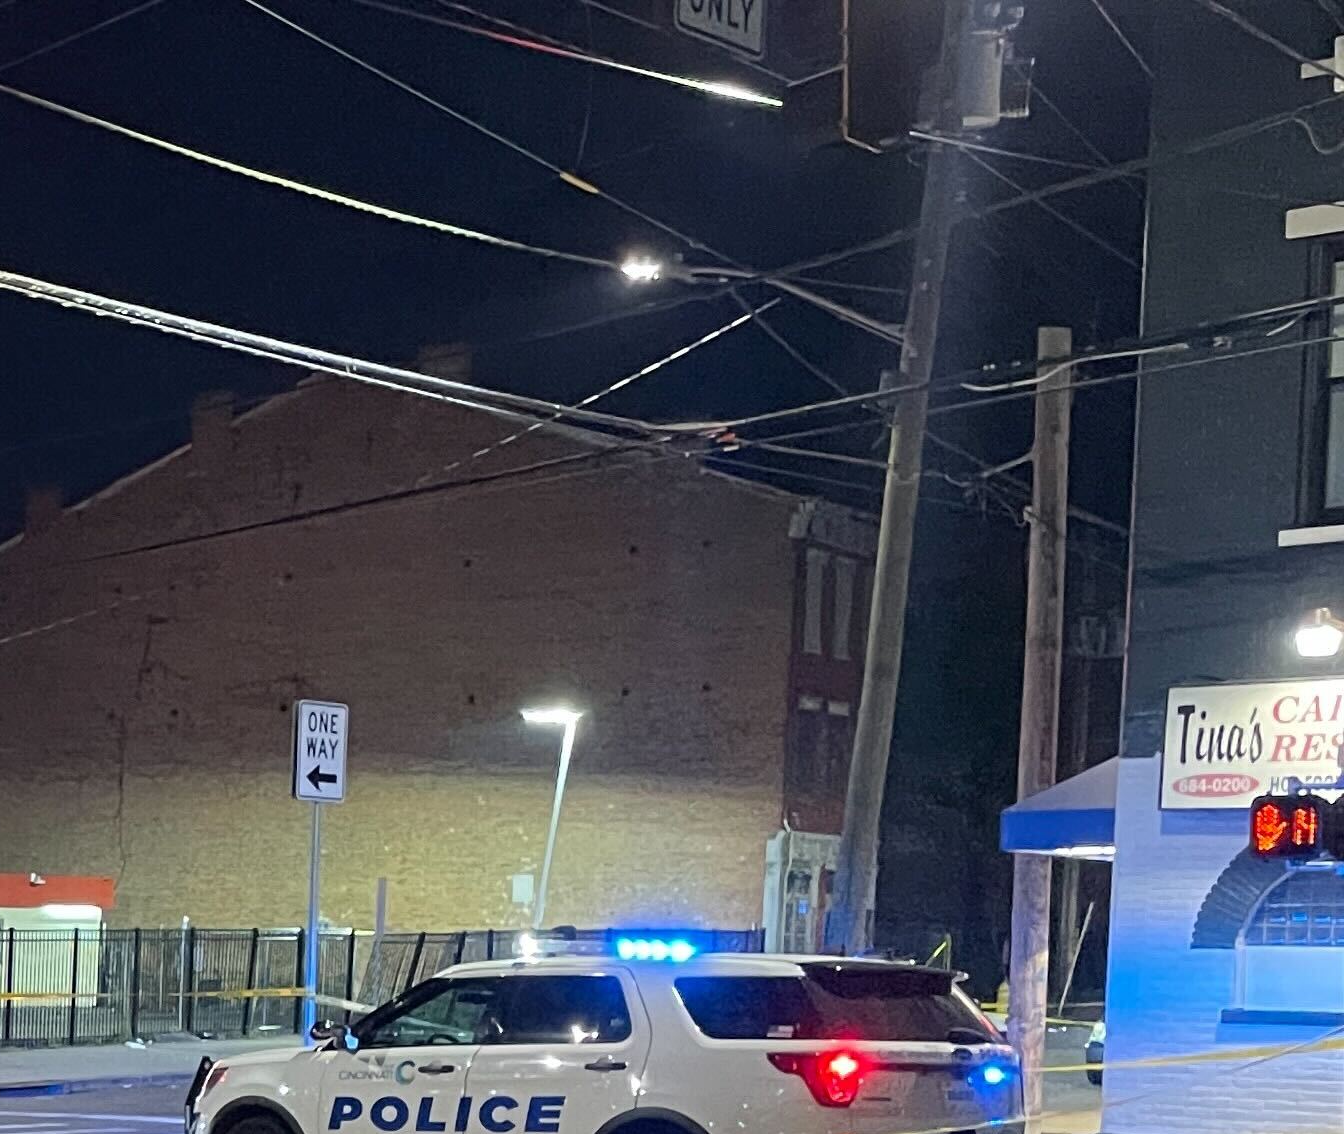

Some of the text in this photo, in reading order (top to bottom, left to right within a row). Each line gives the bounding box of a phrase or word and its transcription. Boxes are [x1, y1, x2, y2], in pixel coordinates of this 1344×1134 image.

[308, 711, 338, 735] ONE
[1178, 704, 1263, 764] Tina's
[307, 737, 339, 760] WAY
[327, 1095, 567, 1133] POLICE
